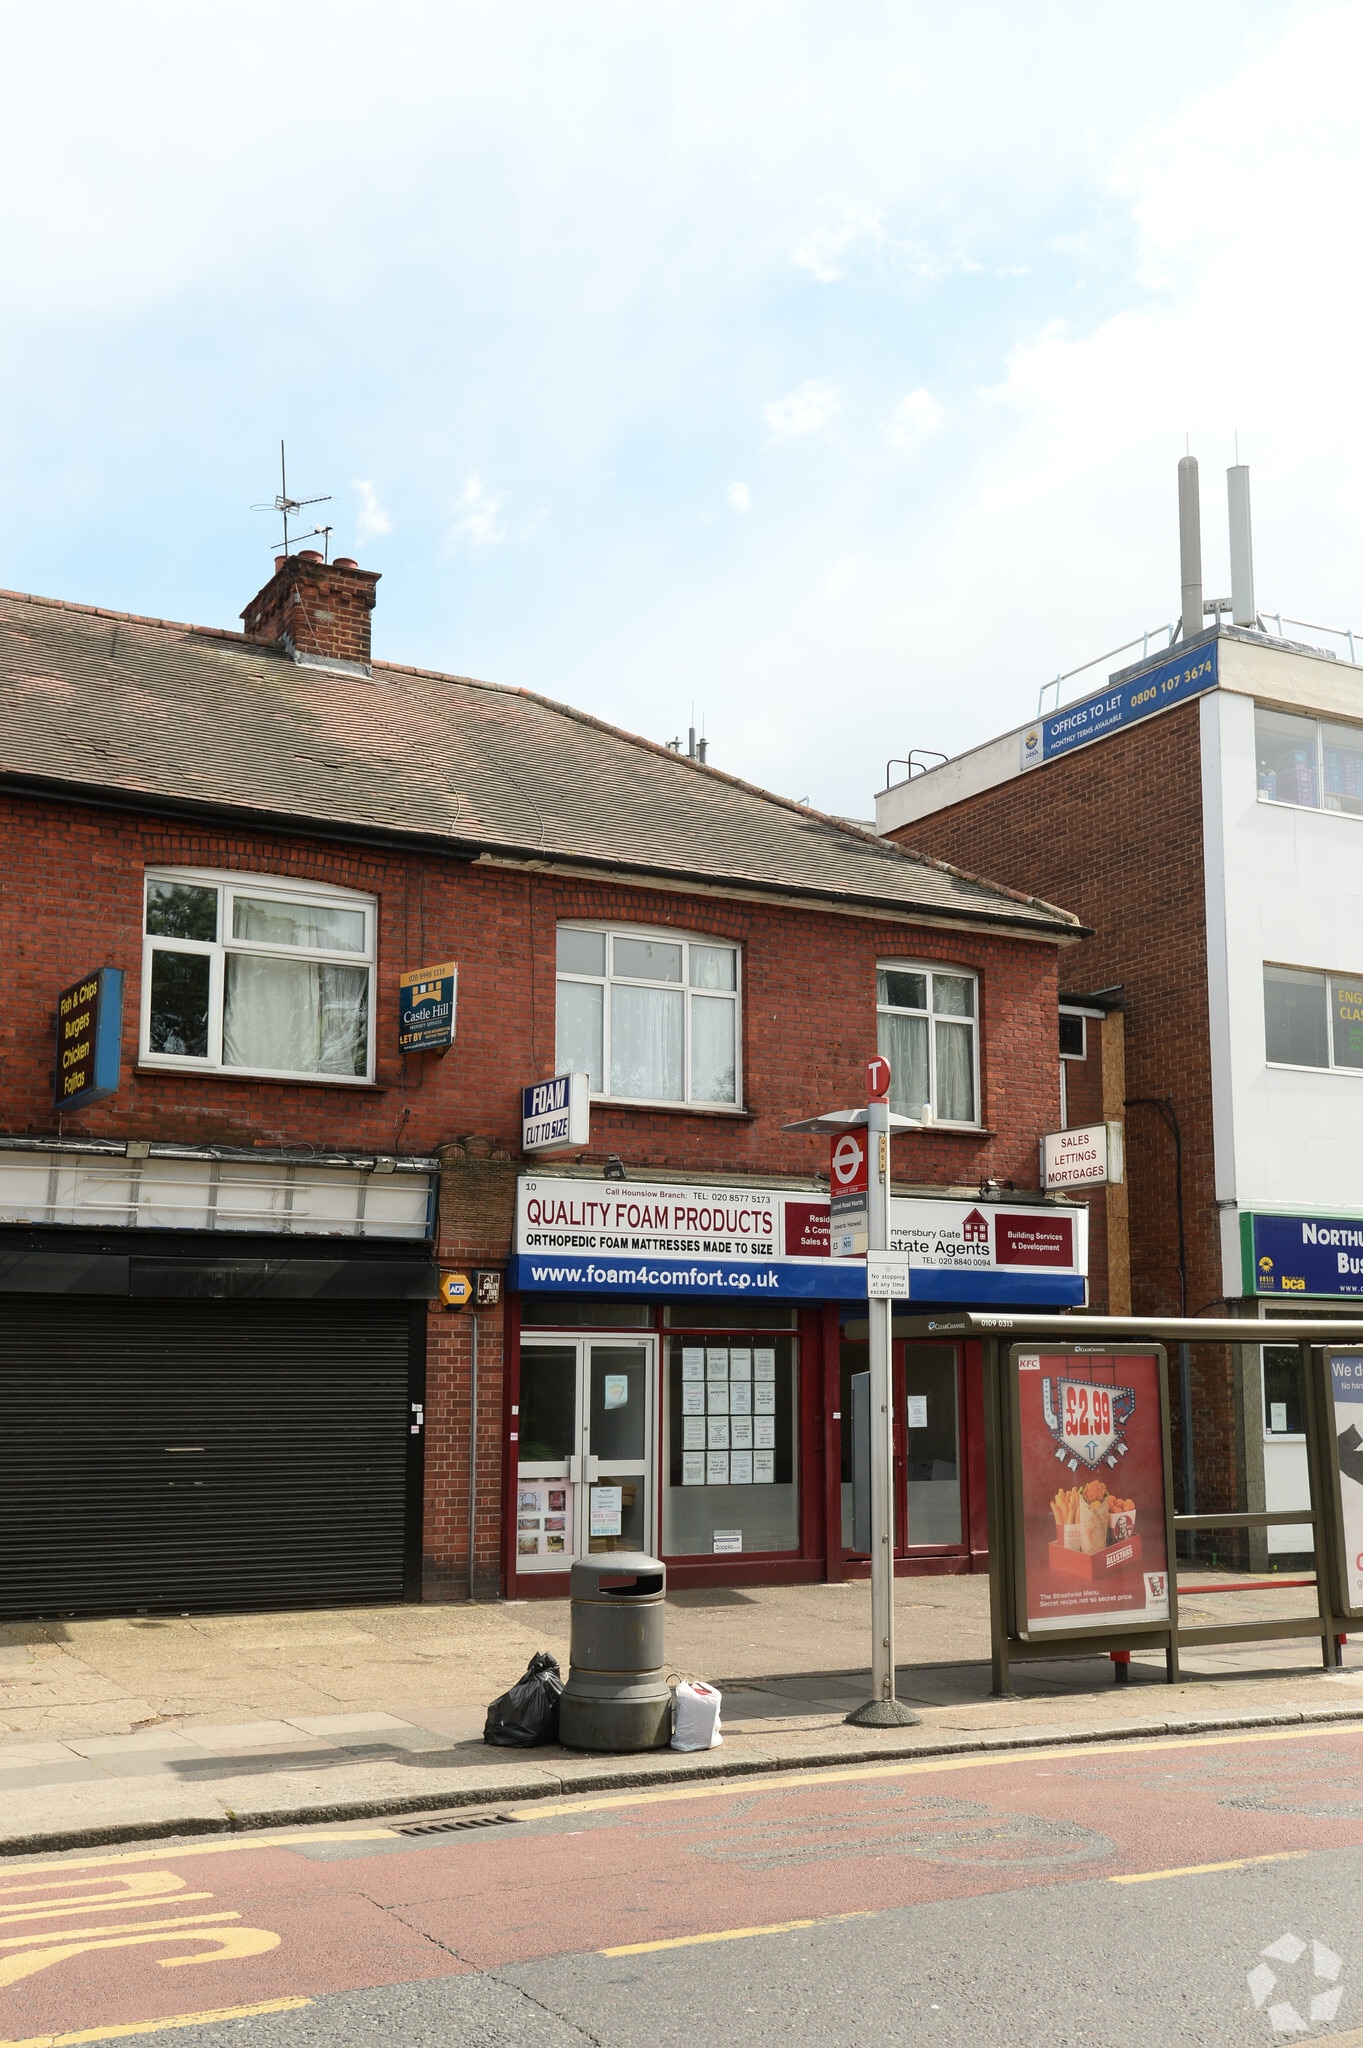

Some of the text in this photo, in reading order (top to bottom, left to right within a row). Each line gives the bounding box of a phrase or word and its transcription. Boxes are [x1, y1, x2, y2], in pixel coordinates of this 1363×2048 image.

[1131, 660, 1212, 707] 0800 107 3674
[1051, 694, 1122, 736] OFFICES TO LET
[1050, 713, 1122, 750] MONTHLY TERMS AVAILABLE
[60, 981, 97, 1016] Fish & Chips
[1338, 989, 1363, 1005] ENG
[403, 1002, 449, 1023] Castle Hill
[65, 1012, 90, 1039] Burgers
[400, 1031, 423, 1044] LET BY
[63, 1041, 90, 1069] Chicken
[64, 1070, 85, 1095] Fajitas
[532, 1079, 566, 1115] FOAM
[526, 1117, 568, 1145] CUT TO SIZE
[1061, 1134, 1090, 1148] SALES
[1054, 1149, 1097, 1166] LETTINGS
[1048, 1165, 1104, 1183] MORTGAGES
[525, 1183, 537, 1191] 10
[605, 1188, 771, 1204] Call Hounslow Branch: TEL: 020 8577 5173
[527, 1199, 773, 1234] QUALITY FOAM PRODUCTS
[809, 1214, 831, 1223] Resid
[804, 1225, 810, 1234] &
[891, 1229, 961, 1239] nnersbury Gate
[1007, 1231, 1063, 1241] Building Services
[526, 1233, 773, 1255] ORTHOPEDIC FOAM MATTRESSES MADE TO SIZE
[800, 1237, 828, 1246] Sales &
[890, 1239, 990, 1257] state Agents
[1011, 1241, 1060, 1252] & Development
[922, 1257, 936, 1265] TEL:
[954, 1258, 972, 1266] 8840
[973, 1259, 991, 1267] 0094
[531, 1264, 779, 1288] www.foam4comfort.co.uk
[1281, 1276, 1305, 1290] bca
[450, 1285, 465, 1294] ADT
[981, 1319, 1013, 1328] 0109 0313
[1332, 1363, 1363, 1377] We d
[1341, 1382, 1350, 1390] No
[1065, 1386, 1110, 1436] £2.99
[1106, 1548, 1133, 1566] ALLSTARS
[1052, 1591, 1082, 1600] Streetwise
[1083, 1589, 1100, 1597] Menu.
[1117, 1593, 1133, 1602] price.
